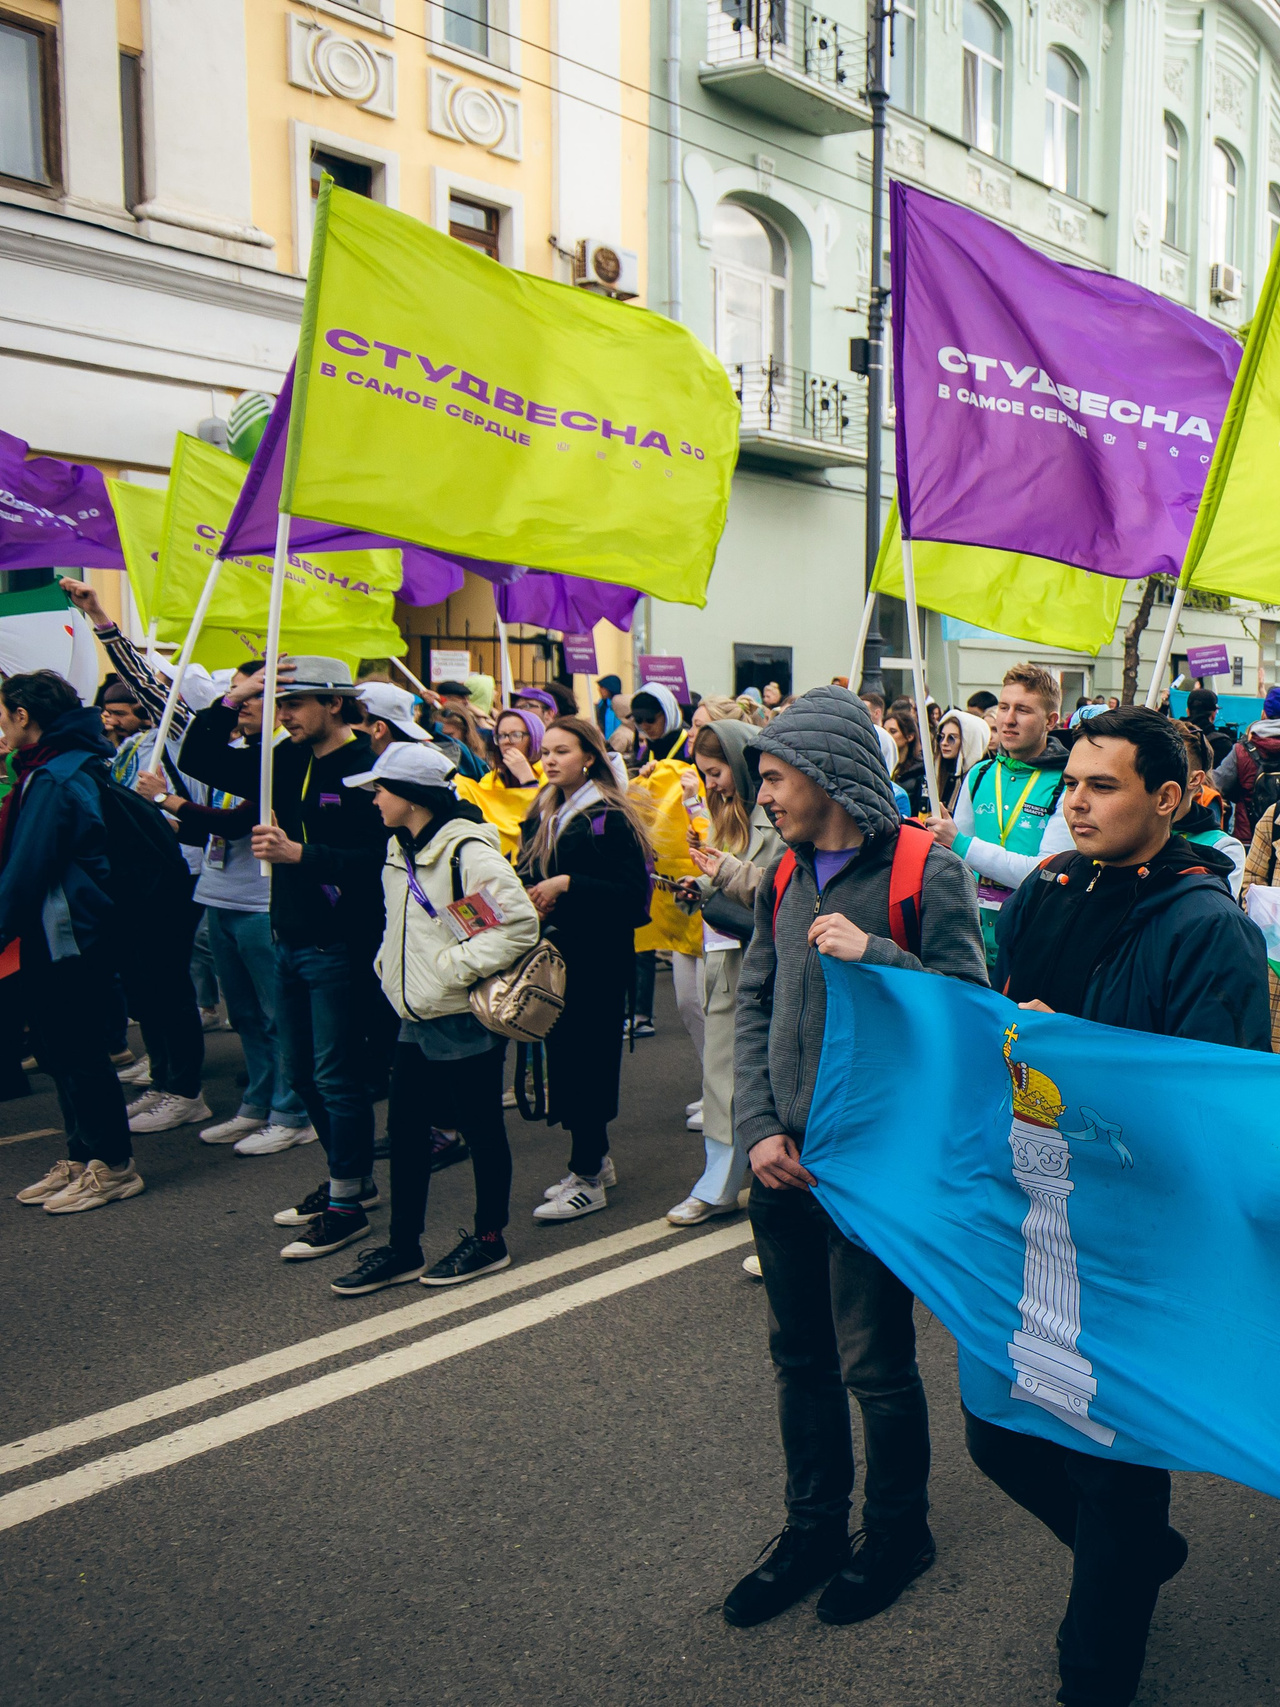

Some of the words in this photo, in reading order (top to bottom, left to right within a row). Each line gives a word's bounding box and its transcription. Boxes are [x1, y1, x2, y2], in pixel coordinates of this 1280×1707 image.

[320, 362, 337, 378] В
[346, 371, 438, 411] САМОЕ
[445, 404, 531, 446] СЕРДЦЕ
[326, 328, 673, 457] СТУДВЕСНА
[679, 441, 705, 461] 30
[937, 346, 1213, 443] СТУДВЕСНА
[938, 383, 950, 399] В
[956, 387, 1025, 416] САМОЕ
[1030, 404, 1088, 439] СЕРДЦЕ
